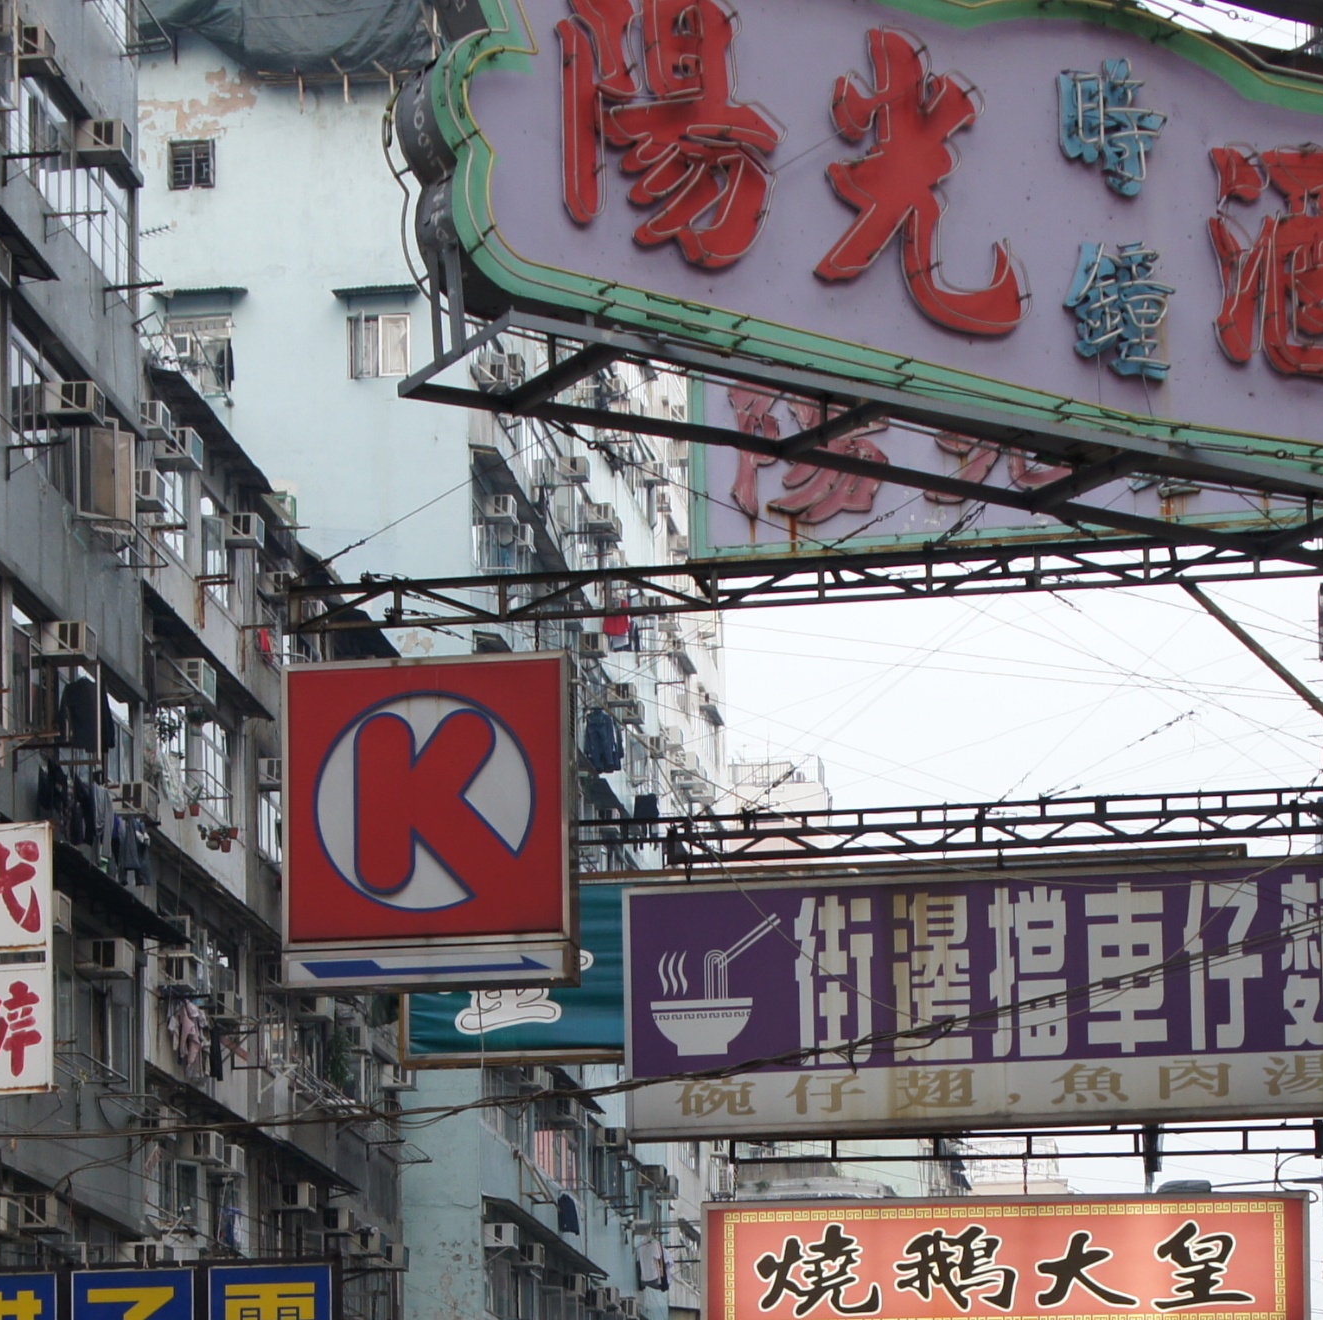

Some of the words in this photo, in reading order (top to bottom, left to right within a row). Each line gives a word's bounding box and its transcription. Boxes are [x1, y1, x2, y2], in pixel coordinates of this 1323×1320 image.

[557, 0, 1030, 336] 陽光
[1059, 57, 1175, 382] 時鐘
[757, 1218, 1256, 1318] 燒鵝大皇
